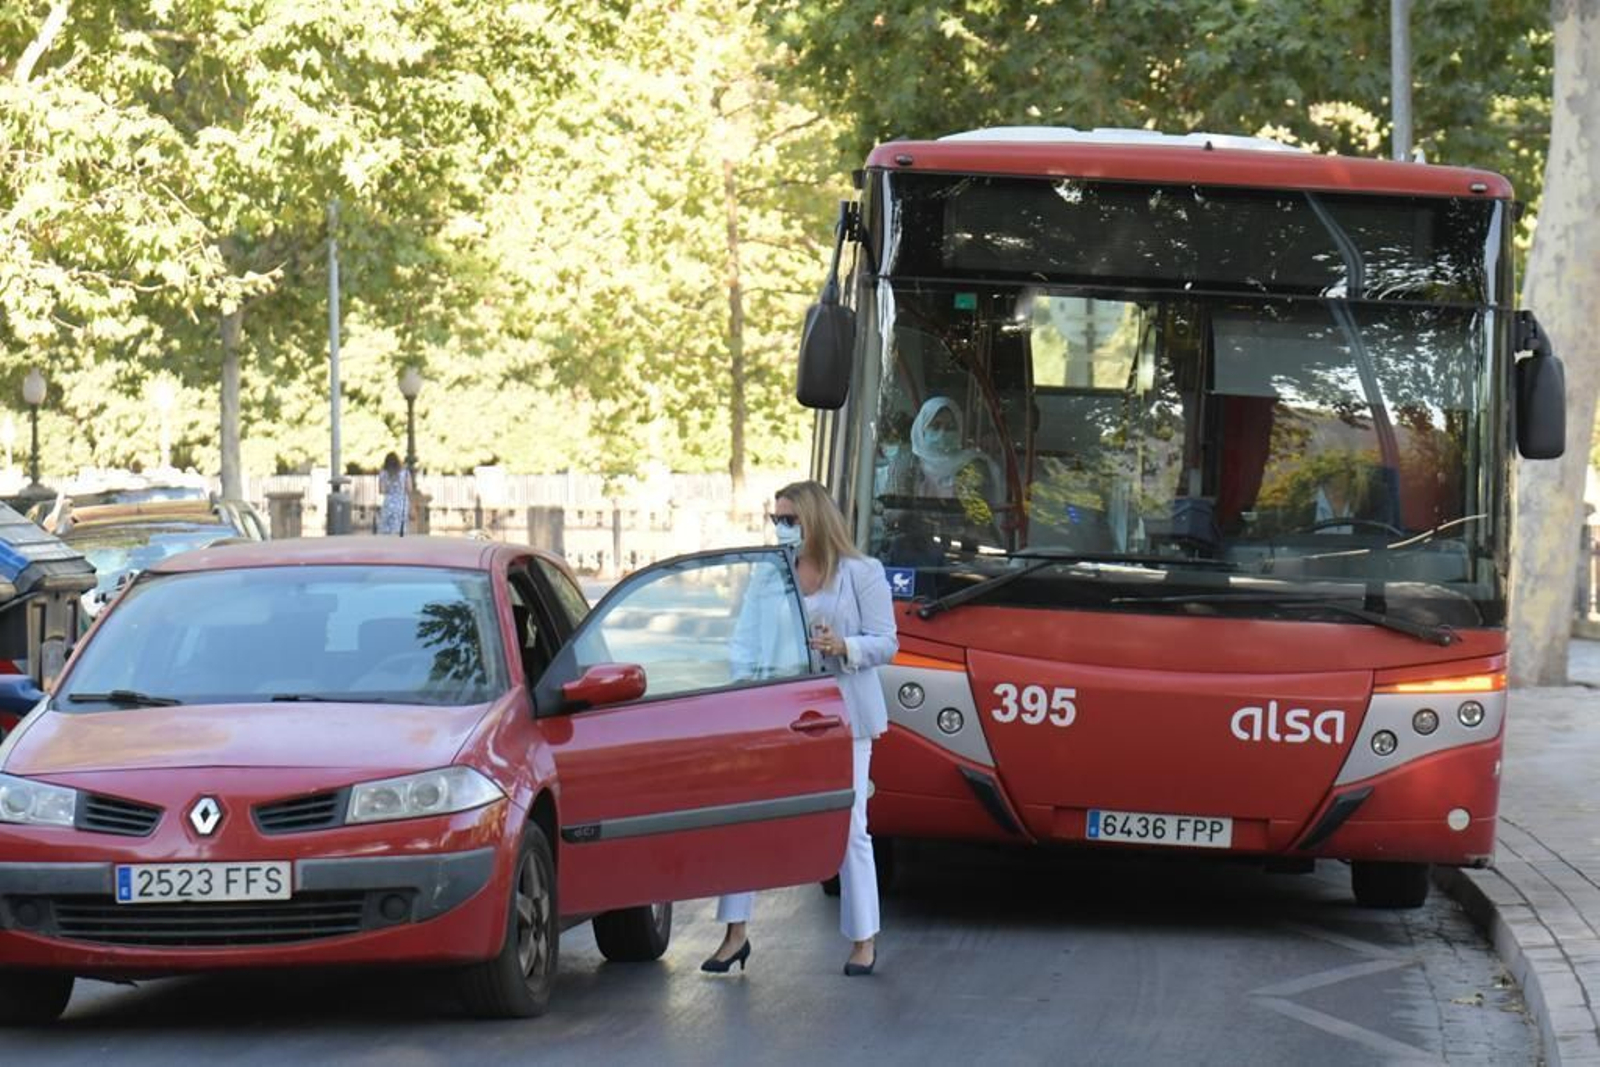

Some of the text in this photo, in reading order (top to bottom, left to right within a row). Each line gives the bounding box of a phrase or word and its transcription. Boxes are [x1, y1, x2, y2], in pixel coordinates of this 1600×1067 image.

[991, 683, 1076, 727] 395
[1230, 700, 1345, 744] alsa
[1103, 814, 1224, 842] 6436 FPP
[138, 866, 282, 897] 2523 FFS
